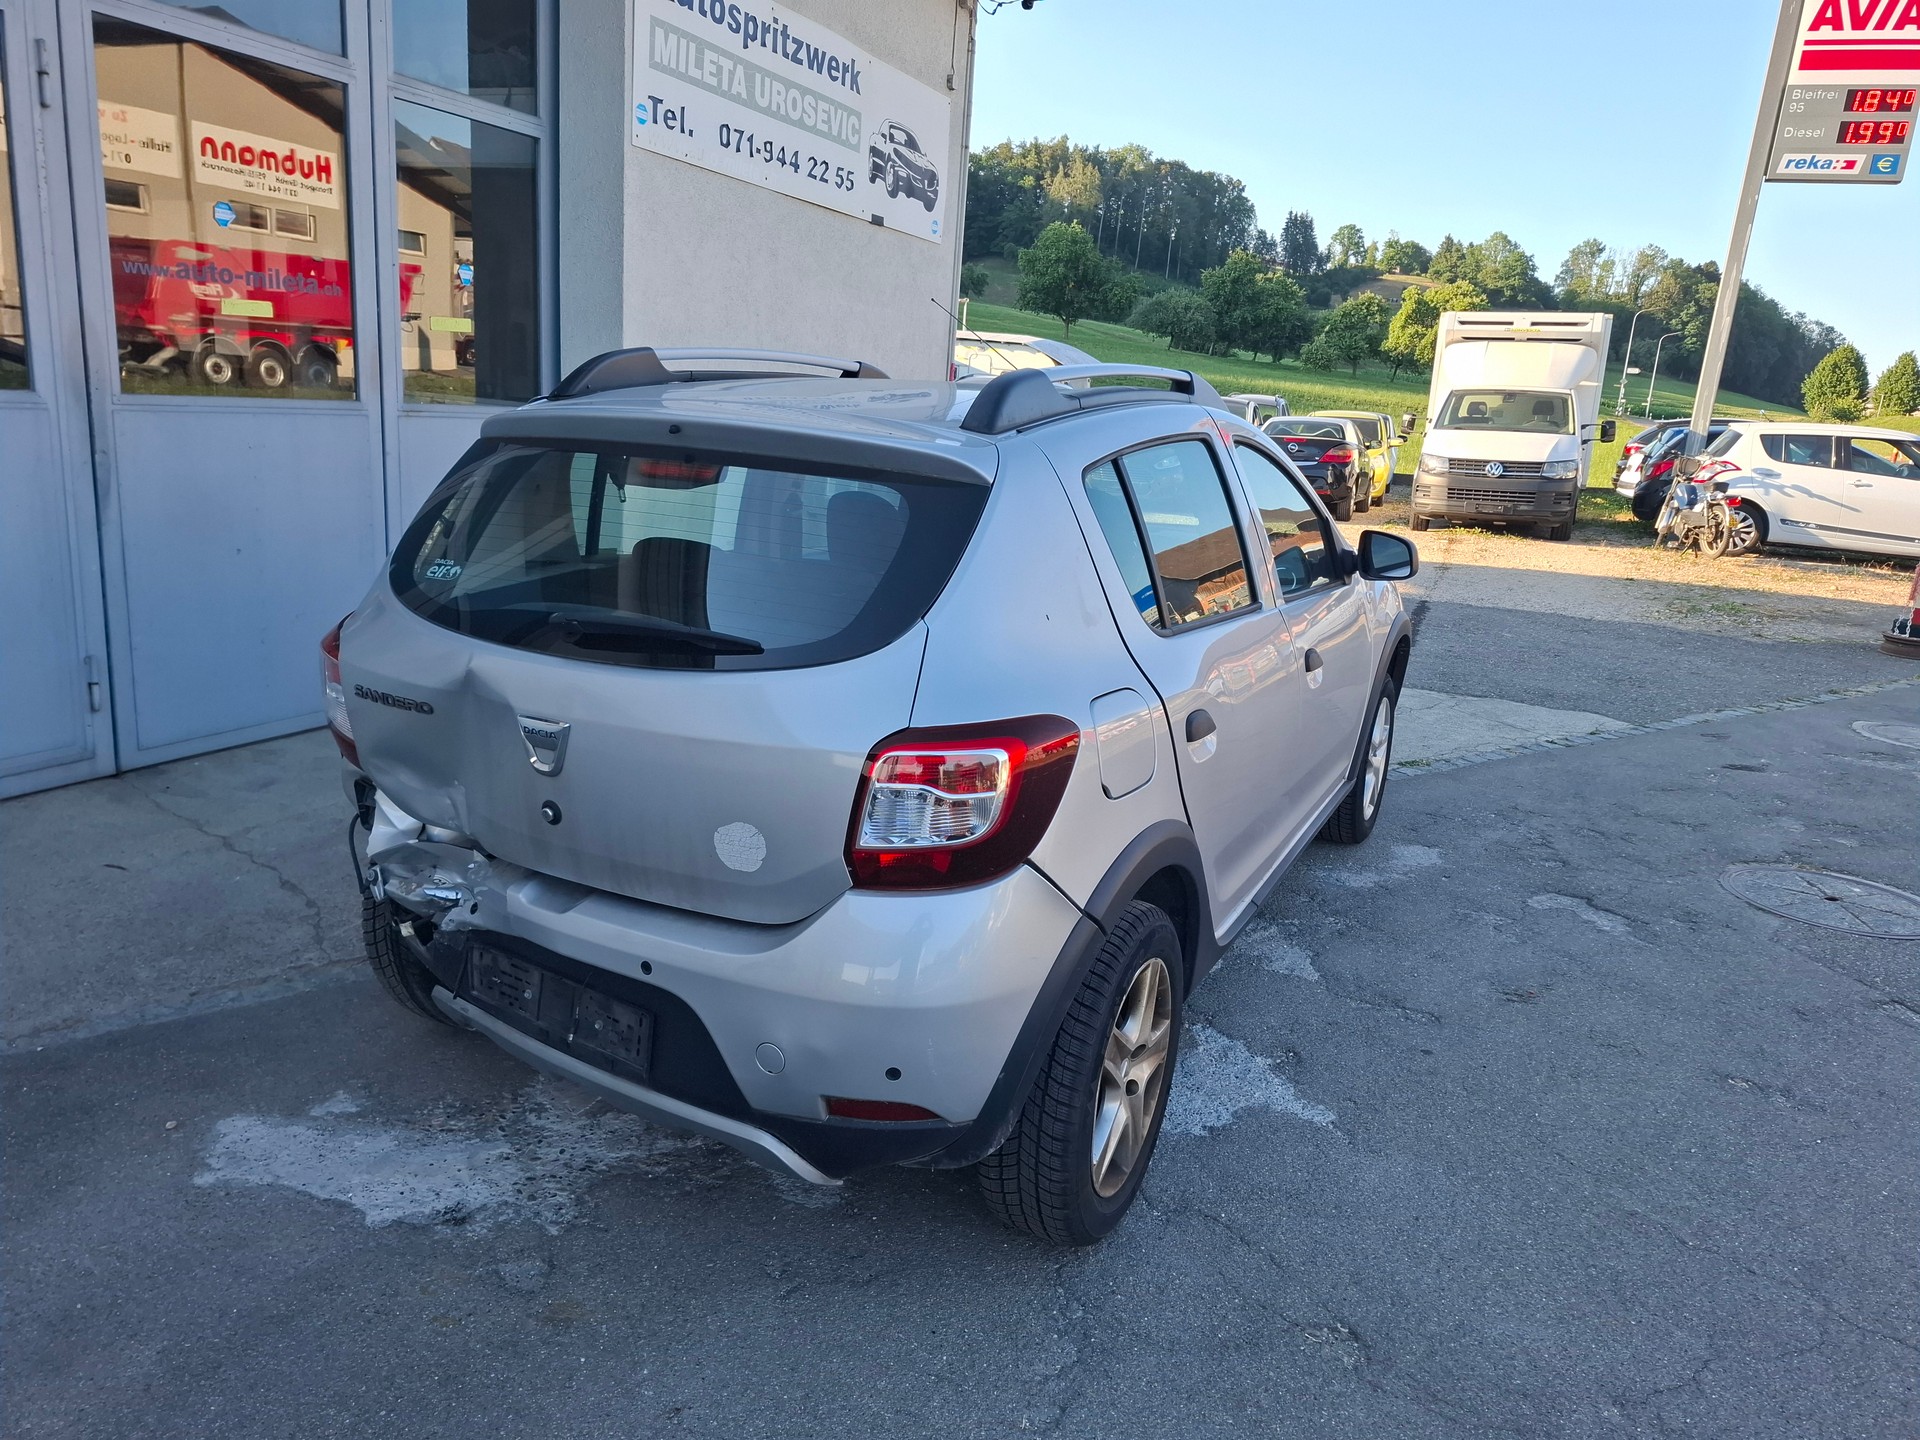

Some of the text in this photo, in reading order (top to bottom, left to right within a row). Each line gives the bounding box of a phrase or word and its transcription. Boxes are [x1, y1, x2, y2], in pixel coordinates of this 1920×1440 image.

[1807, 0, 1920, 32] AVIA
[669, 0, 862, 96] ospritzwerk
[654, 25, 861, 146] MILETA UROSEVIC
[1792, 88, 1840, 100] Bleifrei
[1788, 102, 1805, 113] 95
[647, 94, 694, 138] Tel.
[718, 123, 800, 174] 071-944
[807, 155, 830, 185] 22
[834, 165, 855, 192] 55
[1784, 127, 1826, 138] Diesel
[122, 260, 342, 297] www.auto-mileta.ch
[353, 683, 434, 715] SANDERO
[522, 725, 558, 741] DACIA
